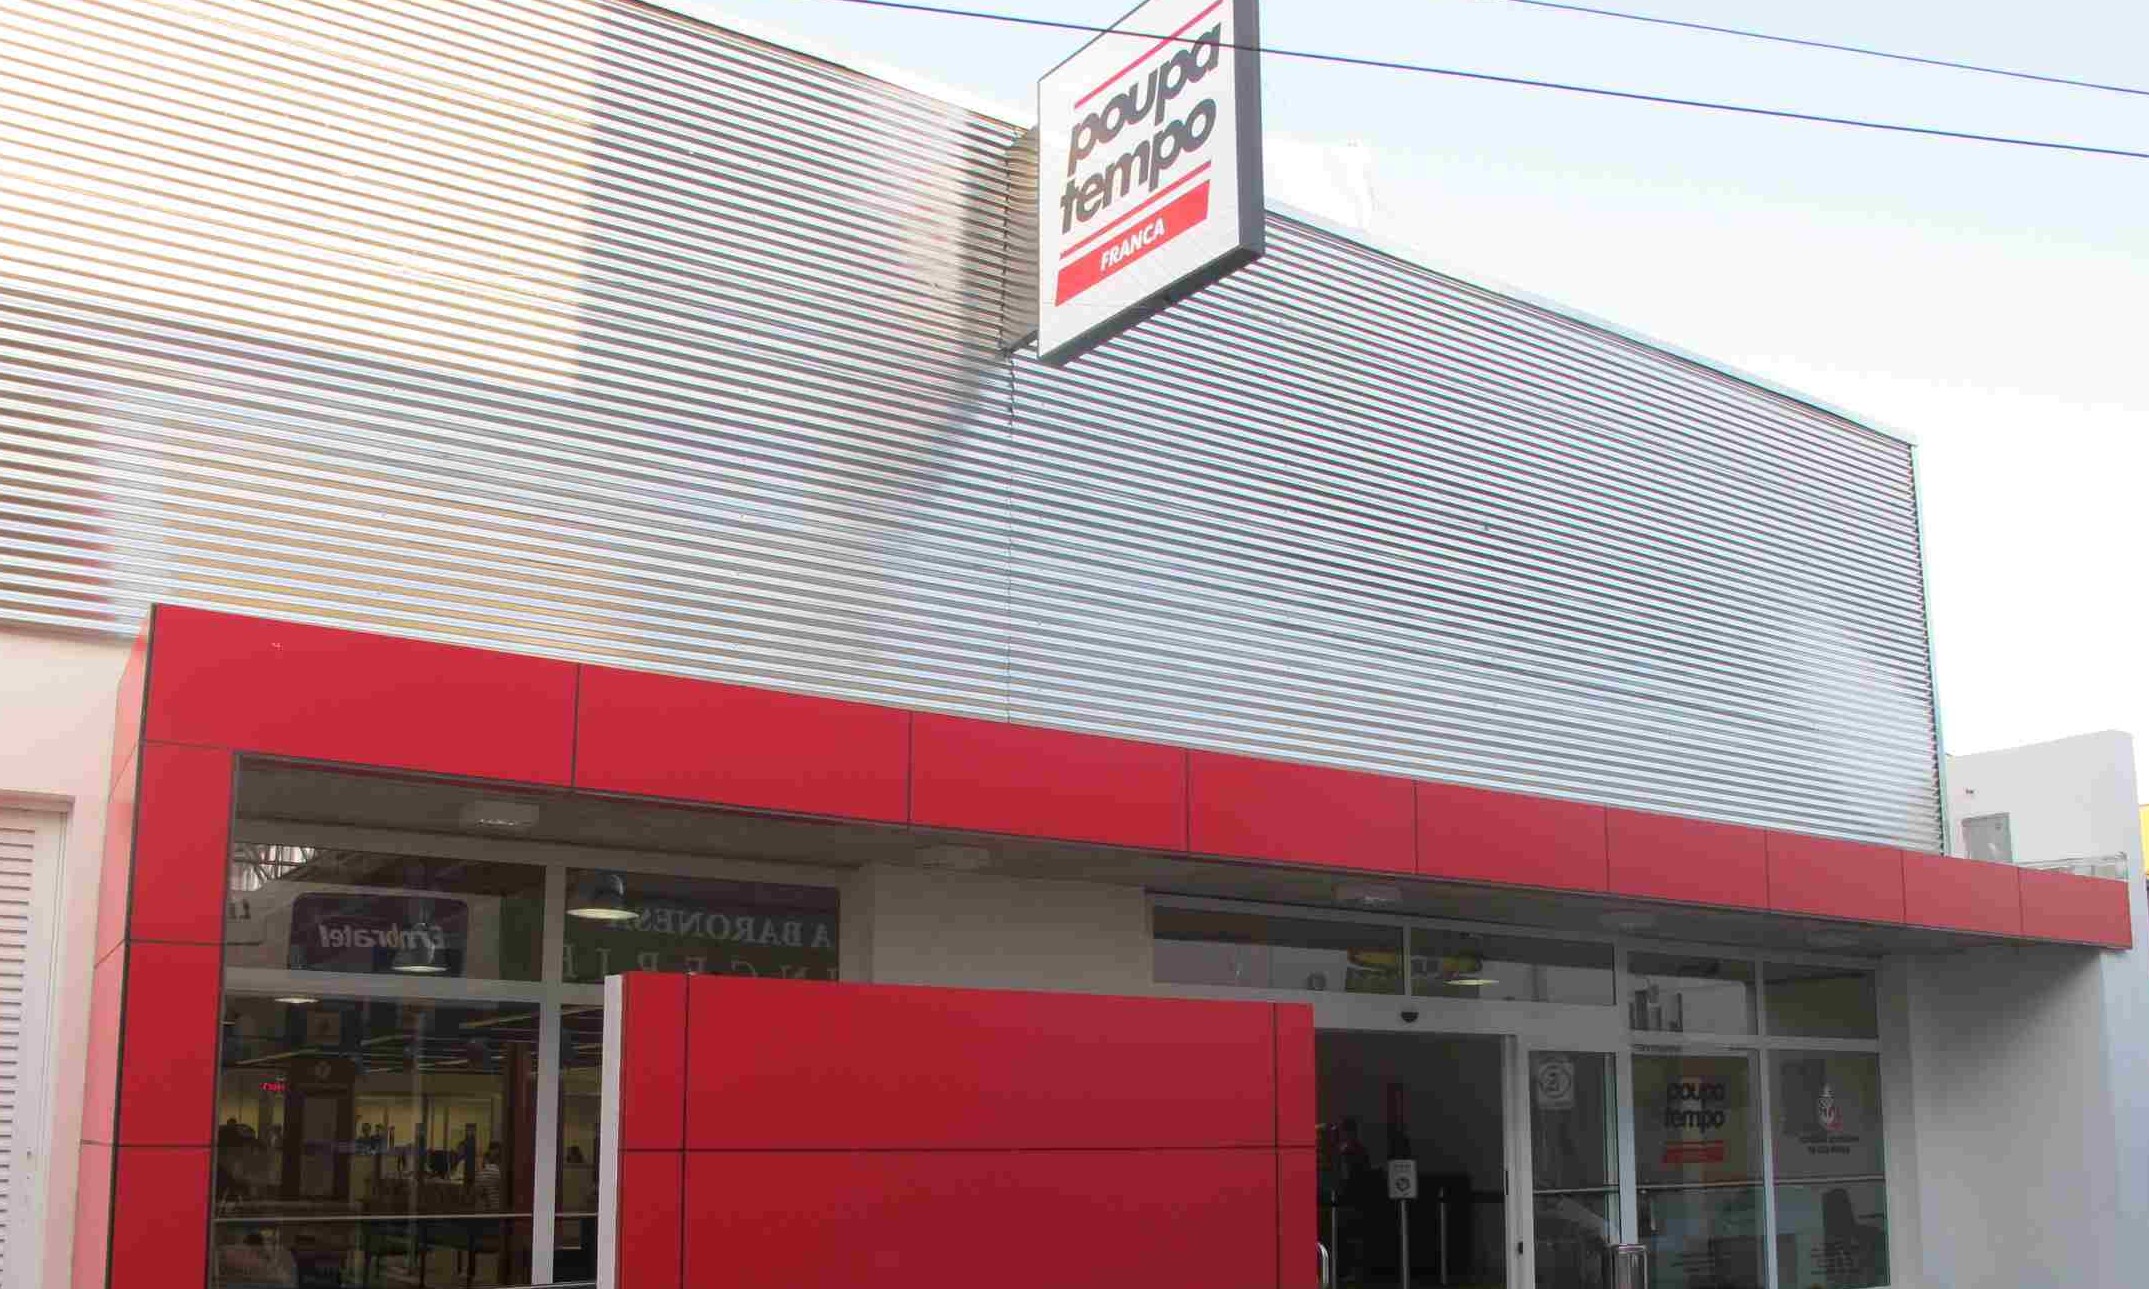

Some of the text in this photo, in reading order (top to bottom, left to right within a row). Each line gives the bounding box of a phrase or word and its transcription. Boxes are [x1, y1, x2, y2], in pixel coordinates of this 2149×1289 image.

[1067, 22, 1222, 178] poupa
[1060, 98, 1217, 235] tempo
[1100, 216, 1166, 272] FRANCA
[1664, 1105, 1726, 1134] tempo
